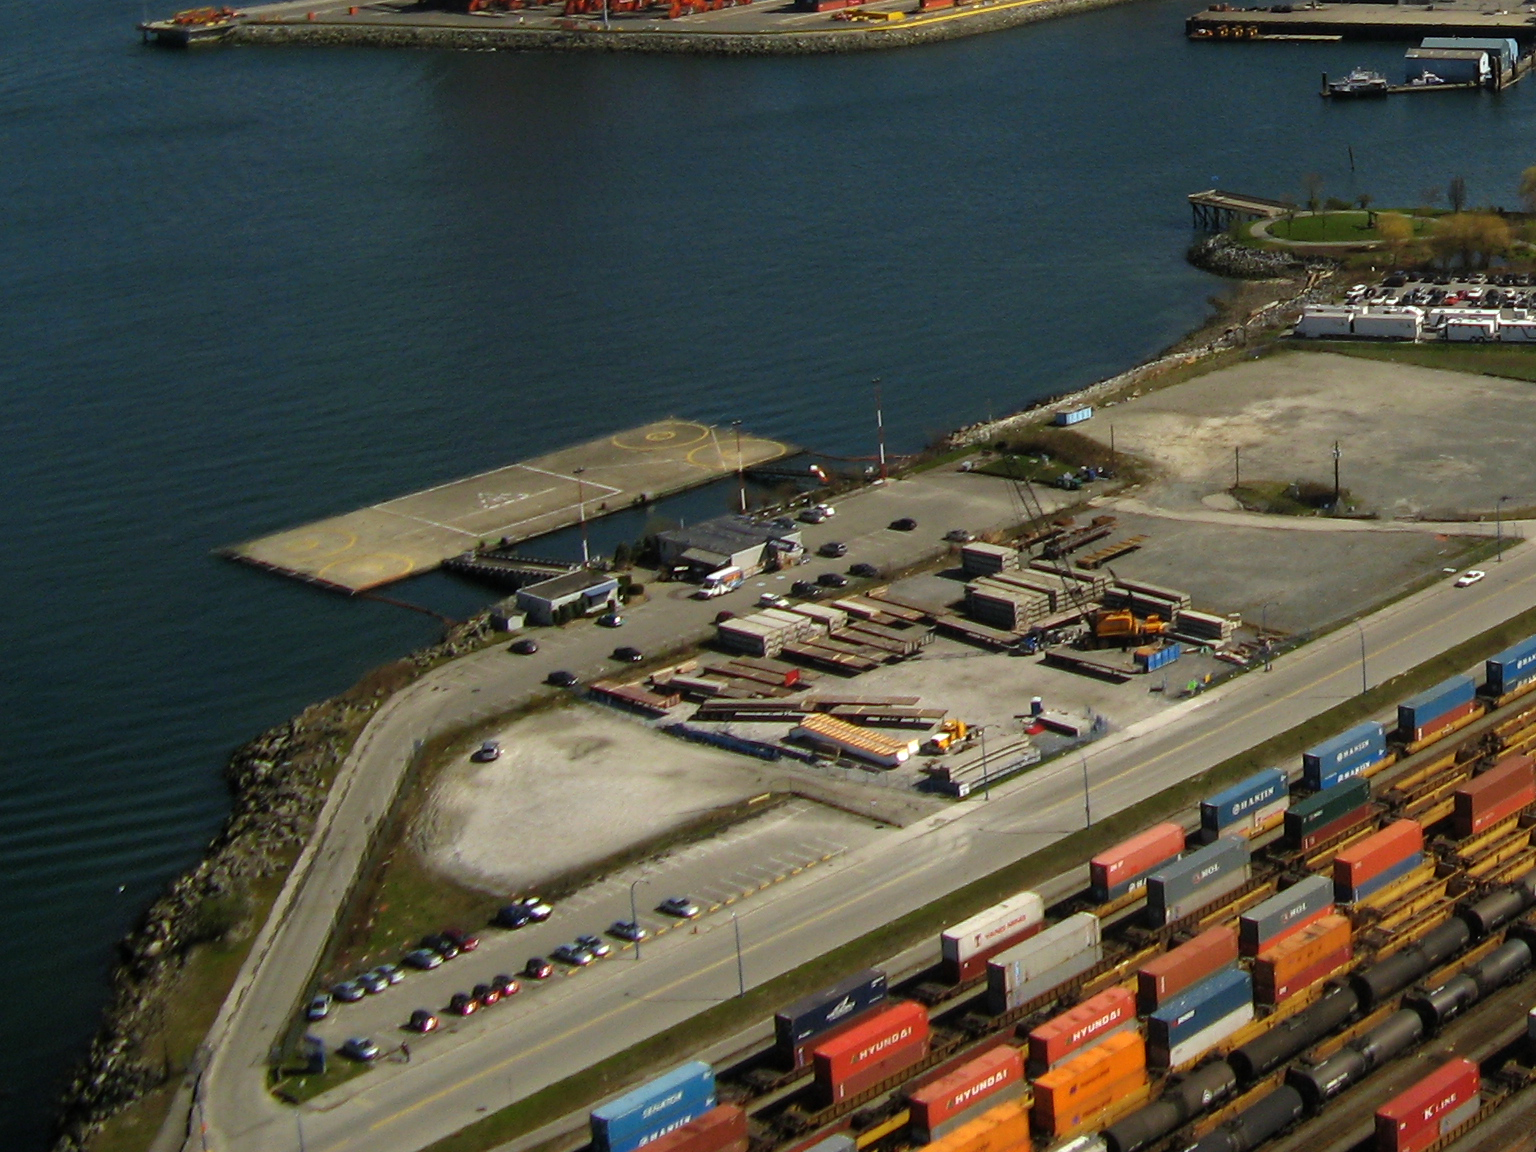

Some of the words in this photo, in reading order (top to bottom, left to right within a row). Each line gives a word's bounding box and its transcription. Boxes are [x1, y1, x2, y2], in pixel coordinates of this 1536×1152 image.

[1342, 739, 1370, 759] HANJIN
[1240, 786, 1275, 810] HANJIN
[1072, 1008, 1121, 1042] HYUNDAI
[859, 1026, 912, 1061] HYUNDAI
[955, 1068, 1008, 1105] HYUNDAI
[1423, 1103, 1436, 1121] K
[1435, 1092, 1457, 1113] LINE
